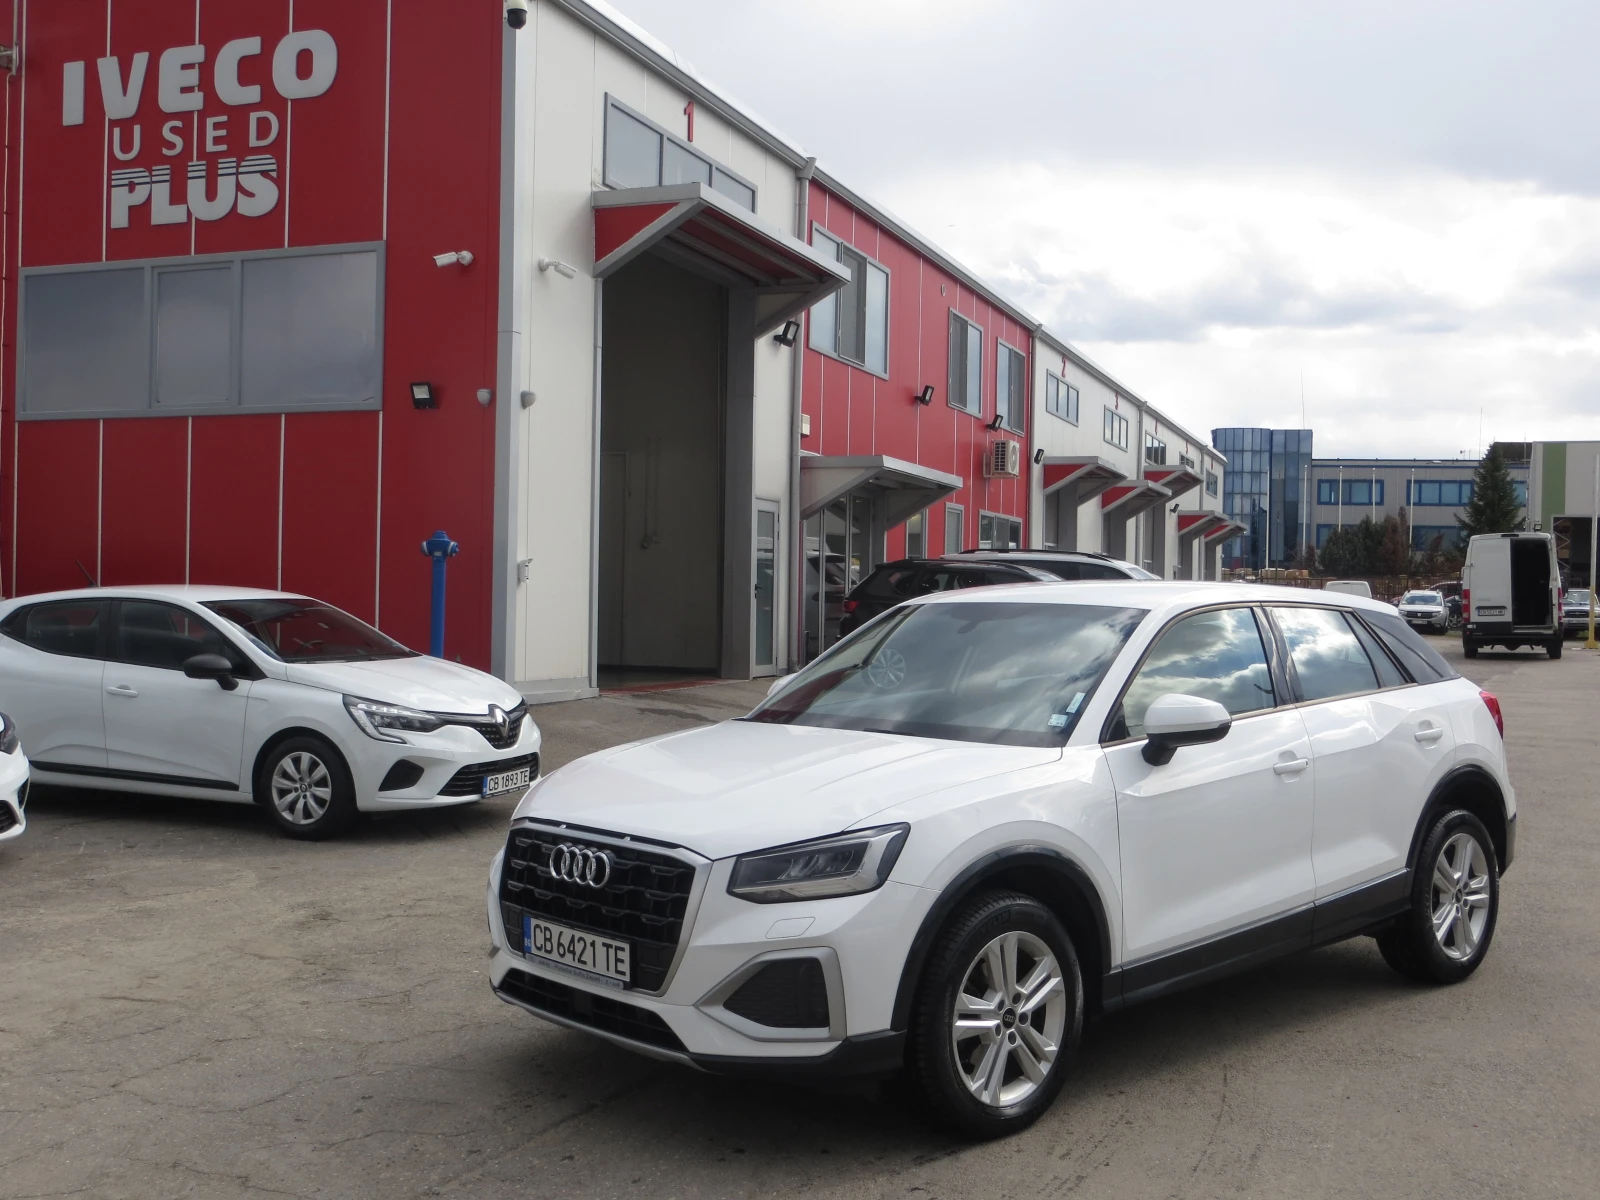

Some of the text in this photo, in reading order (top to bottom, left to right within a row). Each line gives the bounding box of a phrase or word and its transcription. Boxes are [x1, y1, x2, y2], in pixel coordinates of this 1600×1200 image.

[62, 29, 338, 127] IVECO
[112, 110, 279, 161] USED
[684, 101, 695, 143] 1
[110, 154, 279, 229] PLUS
[489, 777, 499, 791] CB
[502, 773, 518, 788] 1893
[520, 770, 528, 783] TE
[533, 923, 627, 976] CB 6421 TE
